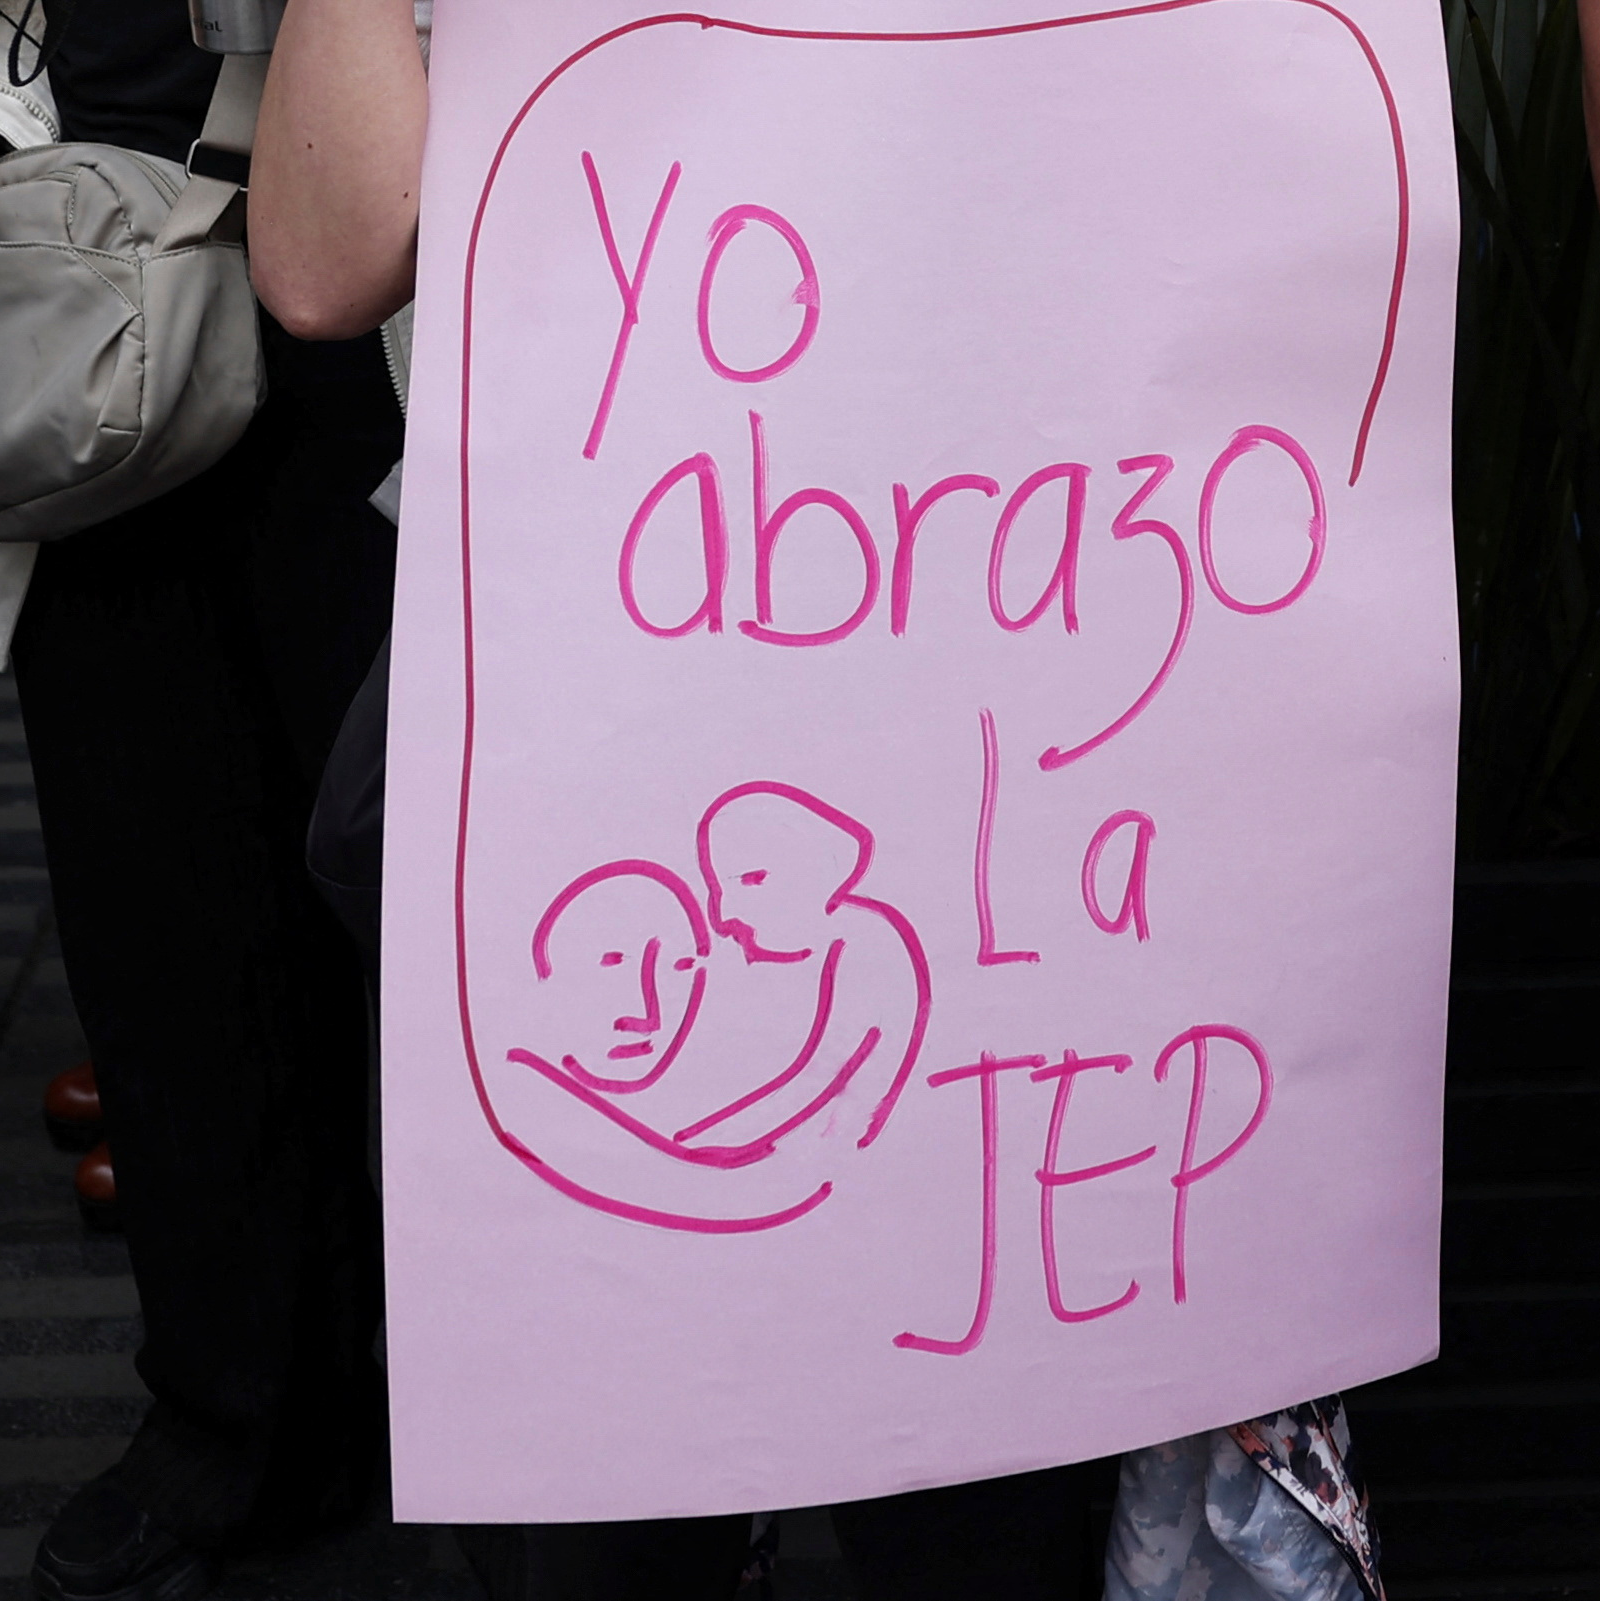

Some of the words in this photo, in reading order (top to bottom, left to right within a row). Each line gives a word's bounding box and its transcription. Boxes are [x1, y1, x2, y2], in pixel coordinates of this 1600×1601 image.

[618, 409, 1327, 770] abrazo
[975, 709, 1156, 966] La
[893, 1023, 1273, 1356] JEP
